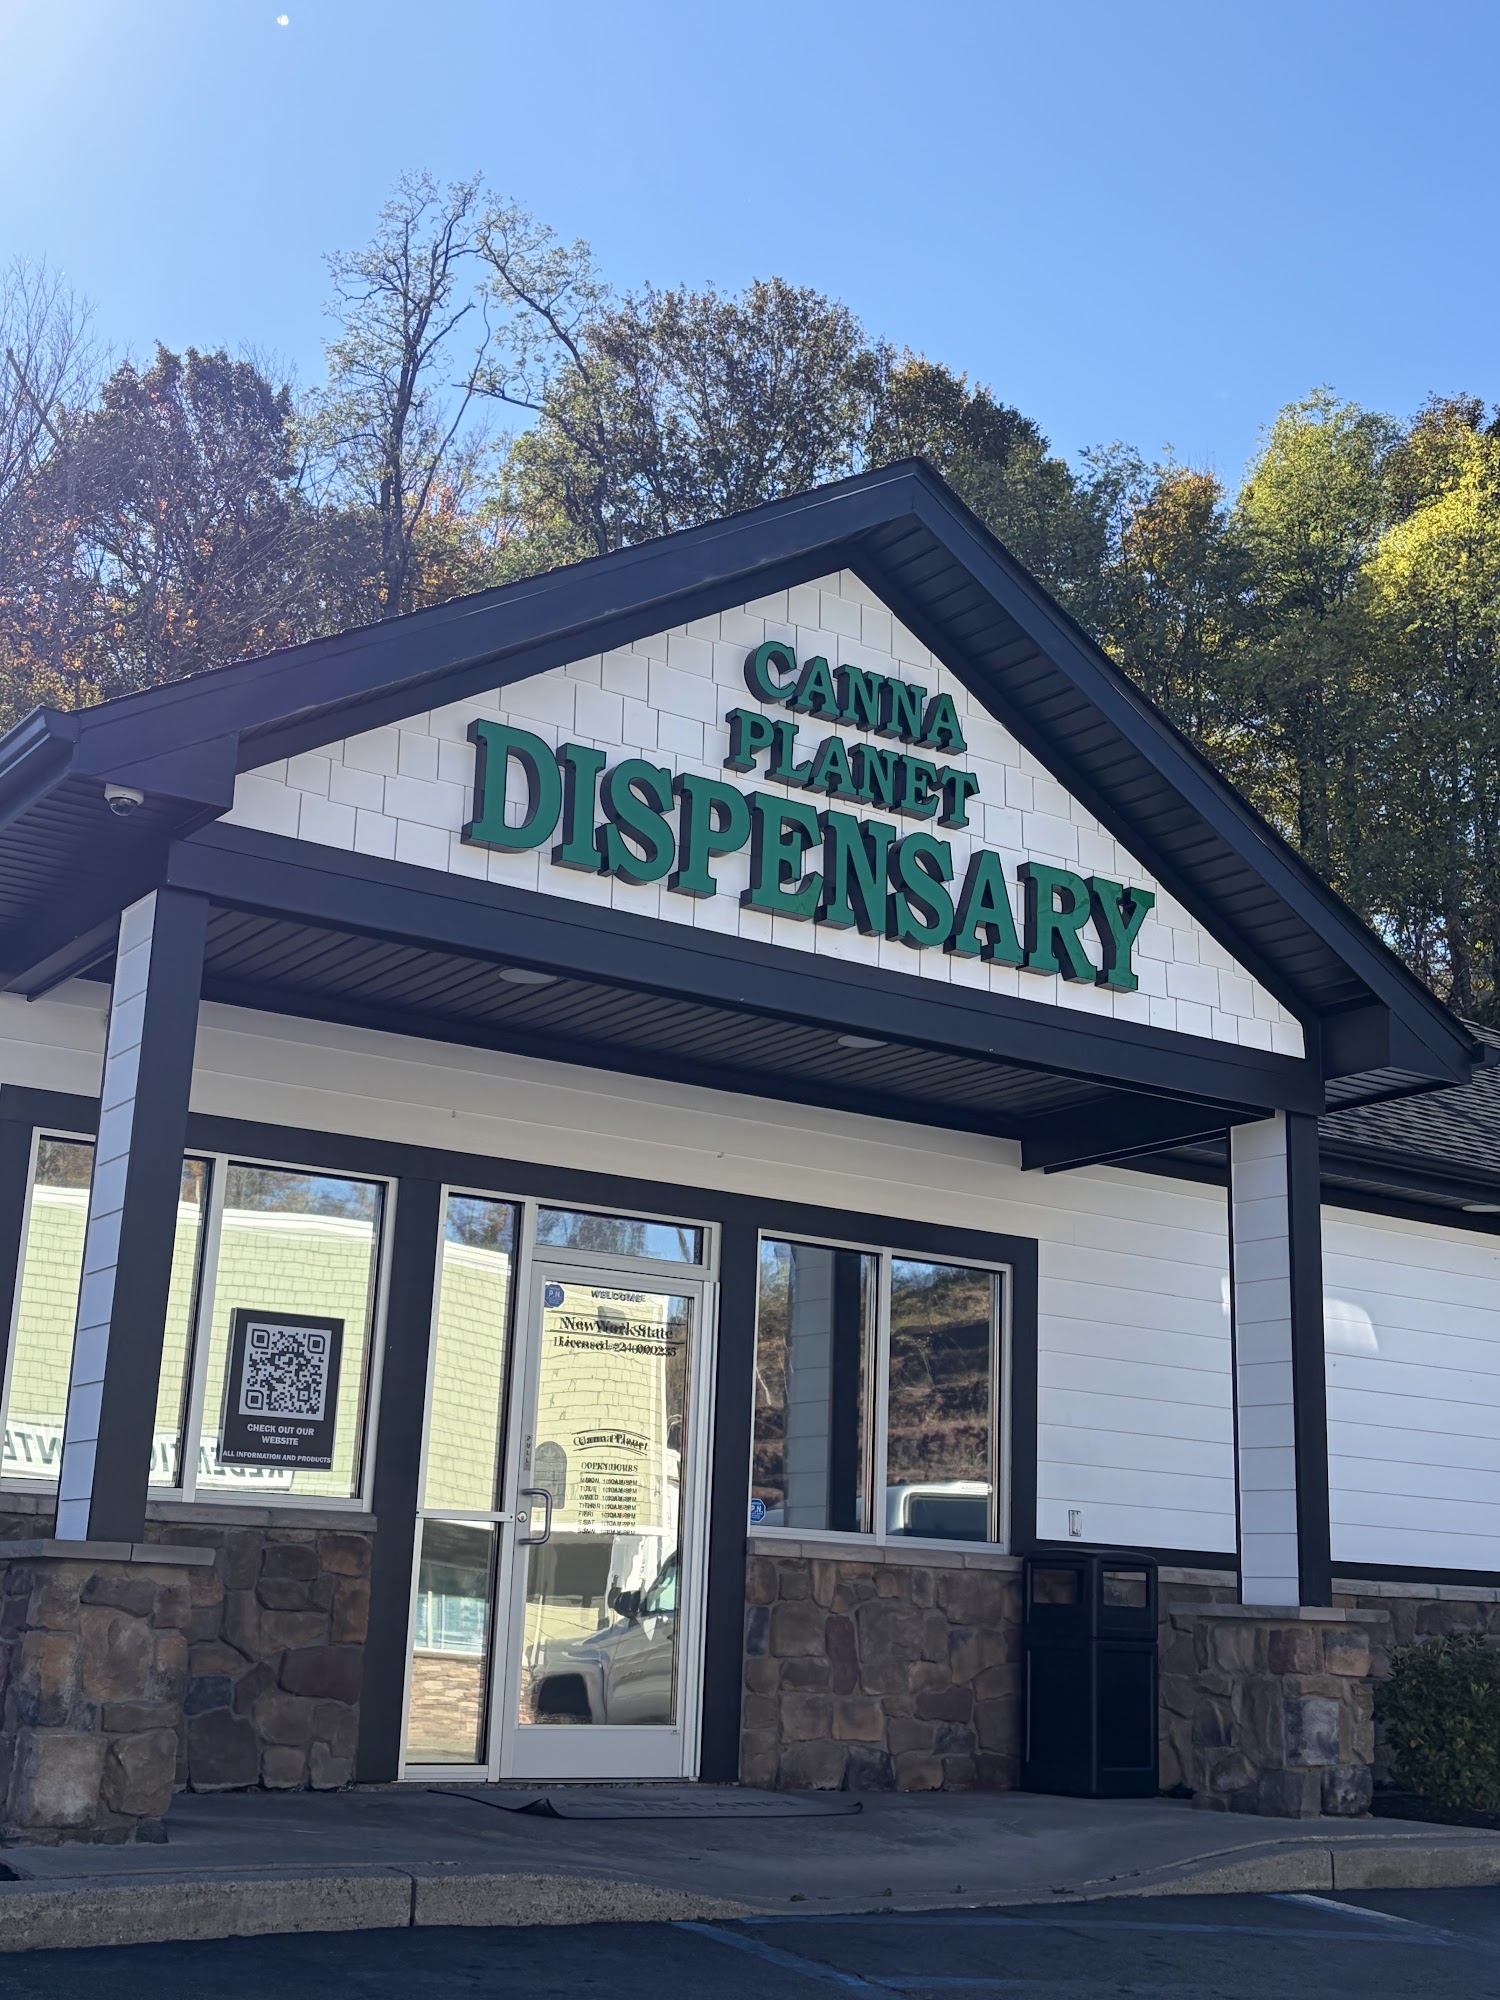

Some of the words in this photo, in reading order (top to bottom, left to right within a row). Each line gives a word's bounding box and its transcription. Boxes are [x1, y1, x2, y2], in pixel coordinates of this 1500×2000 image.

[744, 640, 967, 755] CANNA
[723, 707, 980, 829] PLANET
[461, 718, 1155, 993] DISPENSARY
[591, 1289, 646, 1303] WELCOME
[246, 1423, 276, 1434] CHECK
[277, 1425, 295, 1435] OUT
[296, 1427, 315, 1436] OUR
[261, 1435, 299, 1446] WEBSITE
[236, 1450, 282, 1460] INFORMATION
[297, 1455, 332, 1464] PRODUCTS
